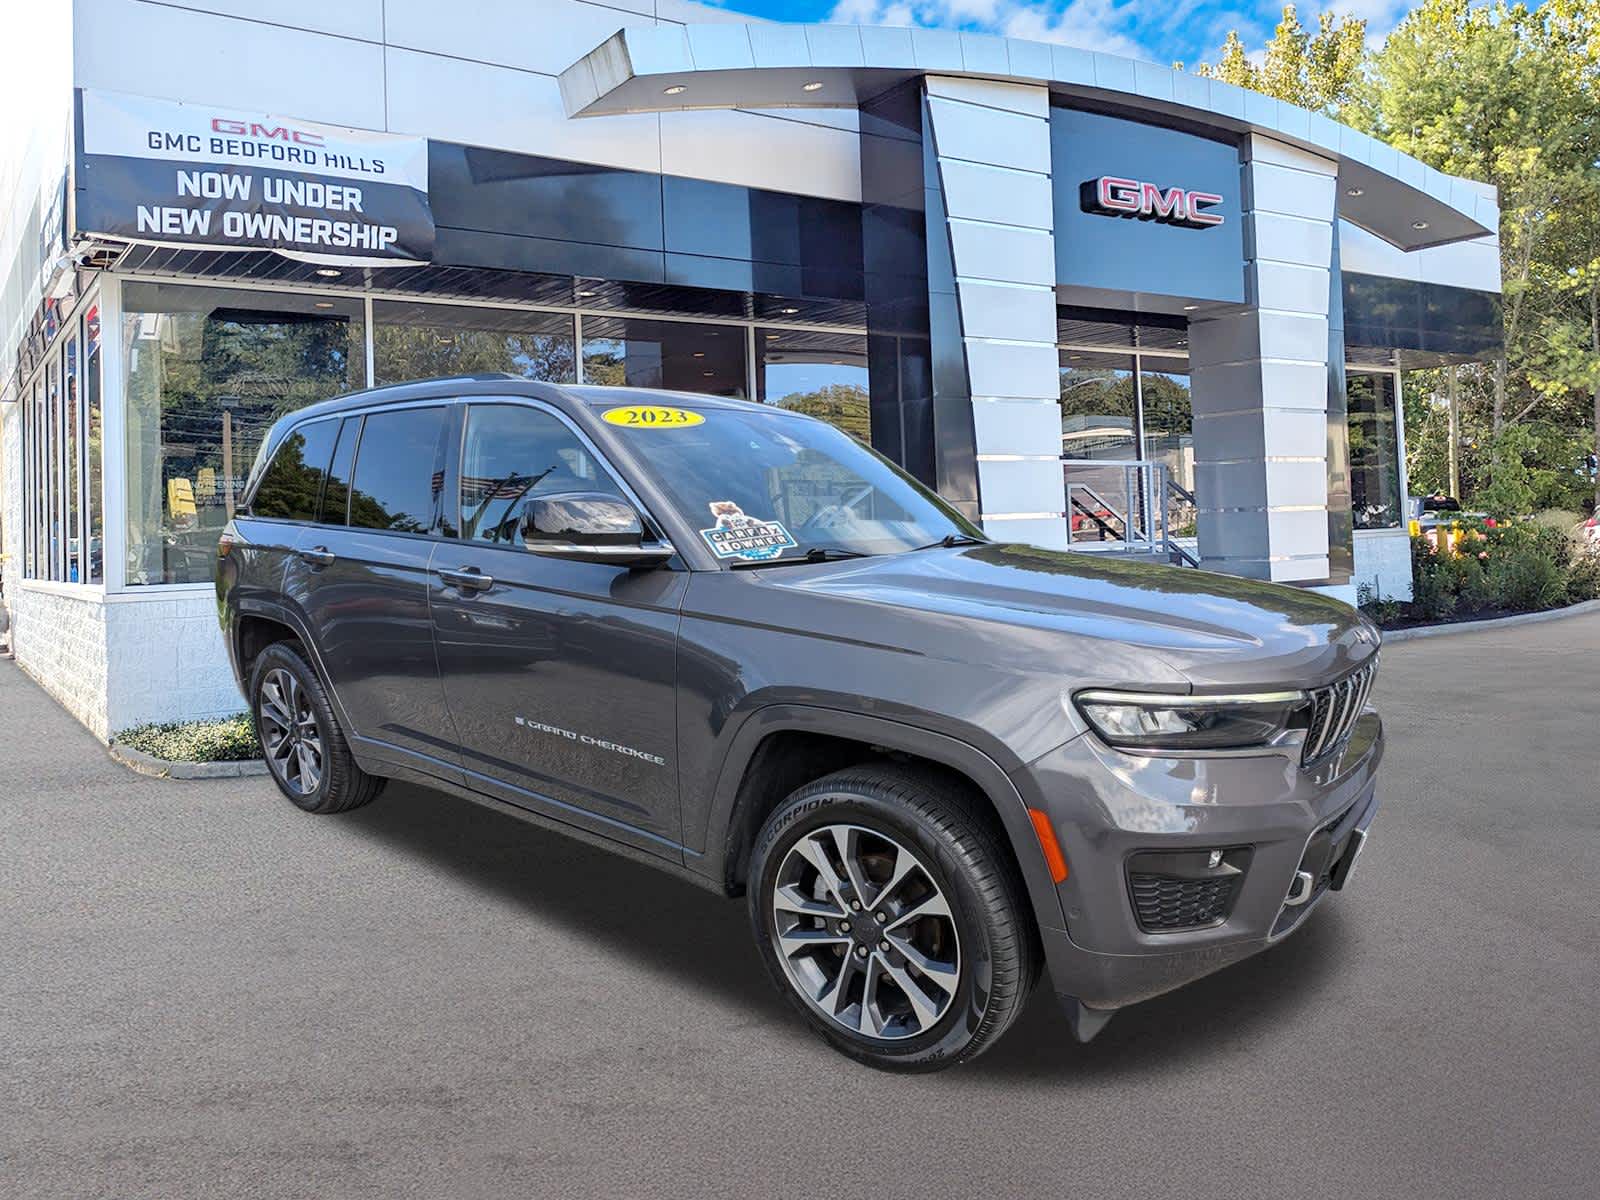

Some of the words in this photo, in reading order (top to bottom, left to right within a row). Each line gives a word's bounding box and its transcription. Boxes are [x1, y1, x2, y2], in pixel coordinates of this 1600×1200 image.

[148, 131, 201, 152] GMC
[210, 138, 316, 165] BEDFORD
[324, 152, 385, 174] HILLS
[211, 118, 326, 148] GMC
[177, 170, 252, 200] NOW
[263, 177, 363, 213] UNDER
[1097, 176, 1224, 224] GMC
[137, 205, 211, 236] NEW
[223, 211, 398, 250] OWNERSHIP
[625, 410, 688, 424] 2023
[711, 526, 780, 542] CARFAX
[527, 720, 577, 740] GRAND
[580, 735, 665, 765] CHEROKEE
